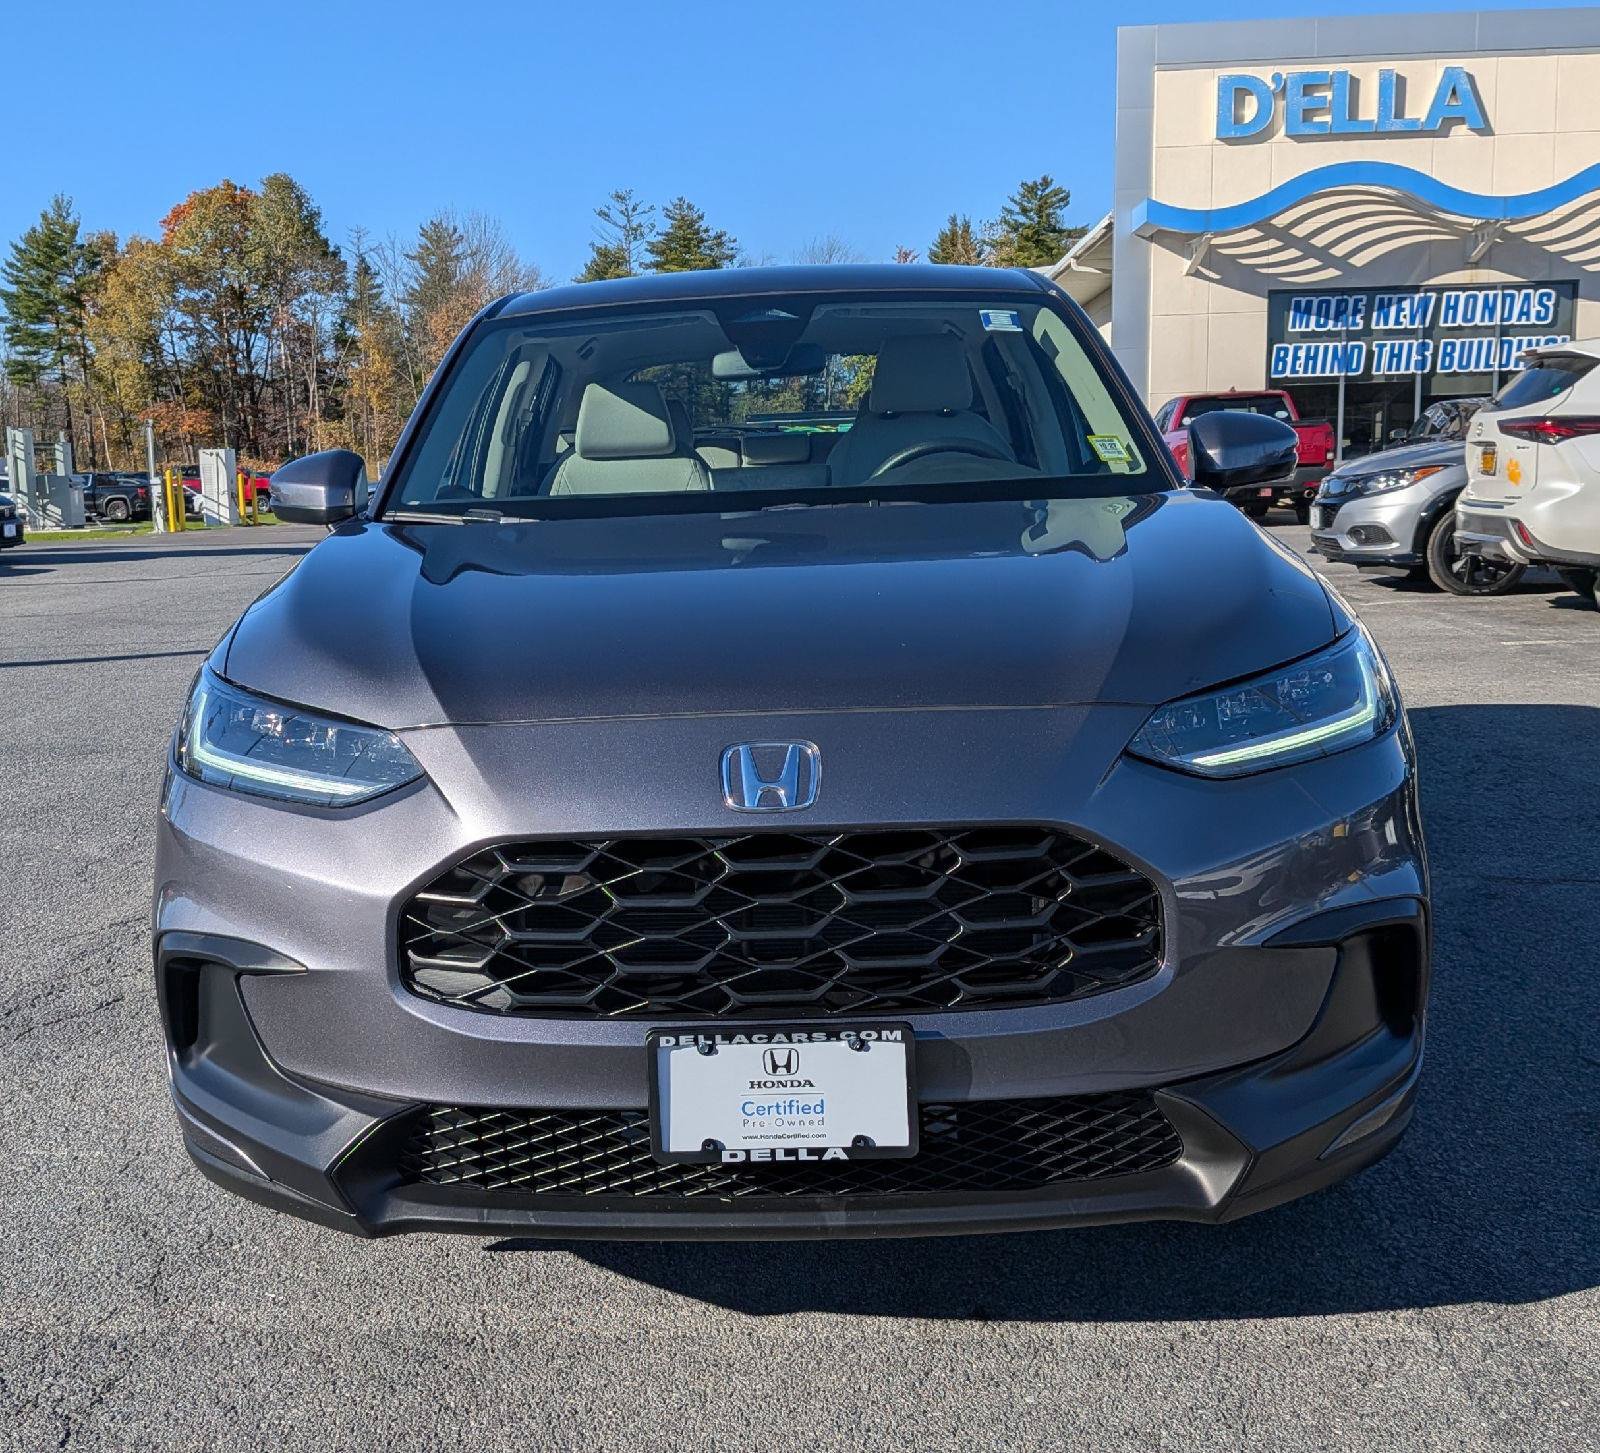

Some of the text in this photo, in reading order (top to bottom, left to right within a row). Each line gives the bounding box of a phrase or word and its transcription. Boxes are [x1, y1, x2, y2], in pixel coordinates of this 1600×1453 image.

[1216, 66, 1486, 139] D'ELLA
[1288, 288, 1556, 332] MORE NEW HONDAS
[1271, 341, 1367, 378] BEHIND
[1372, 338, 1434, 374] THIS
[659, 1029, 903, 1048] DELLACARS.COM
[748, 1079, 816, 1090] HONDA
[741, 1099, 825, 1117] Certified
[721, 1147, 850, 1163] DELLA
